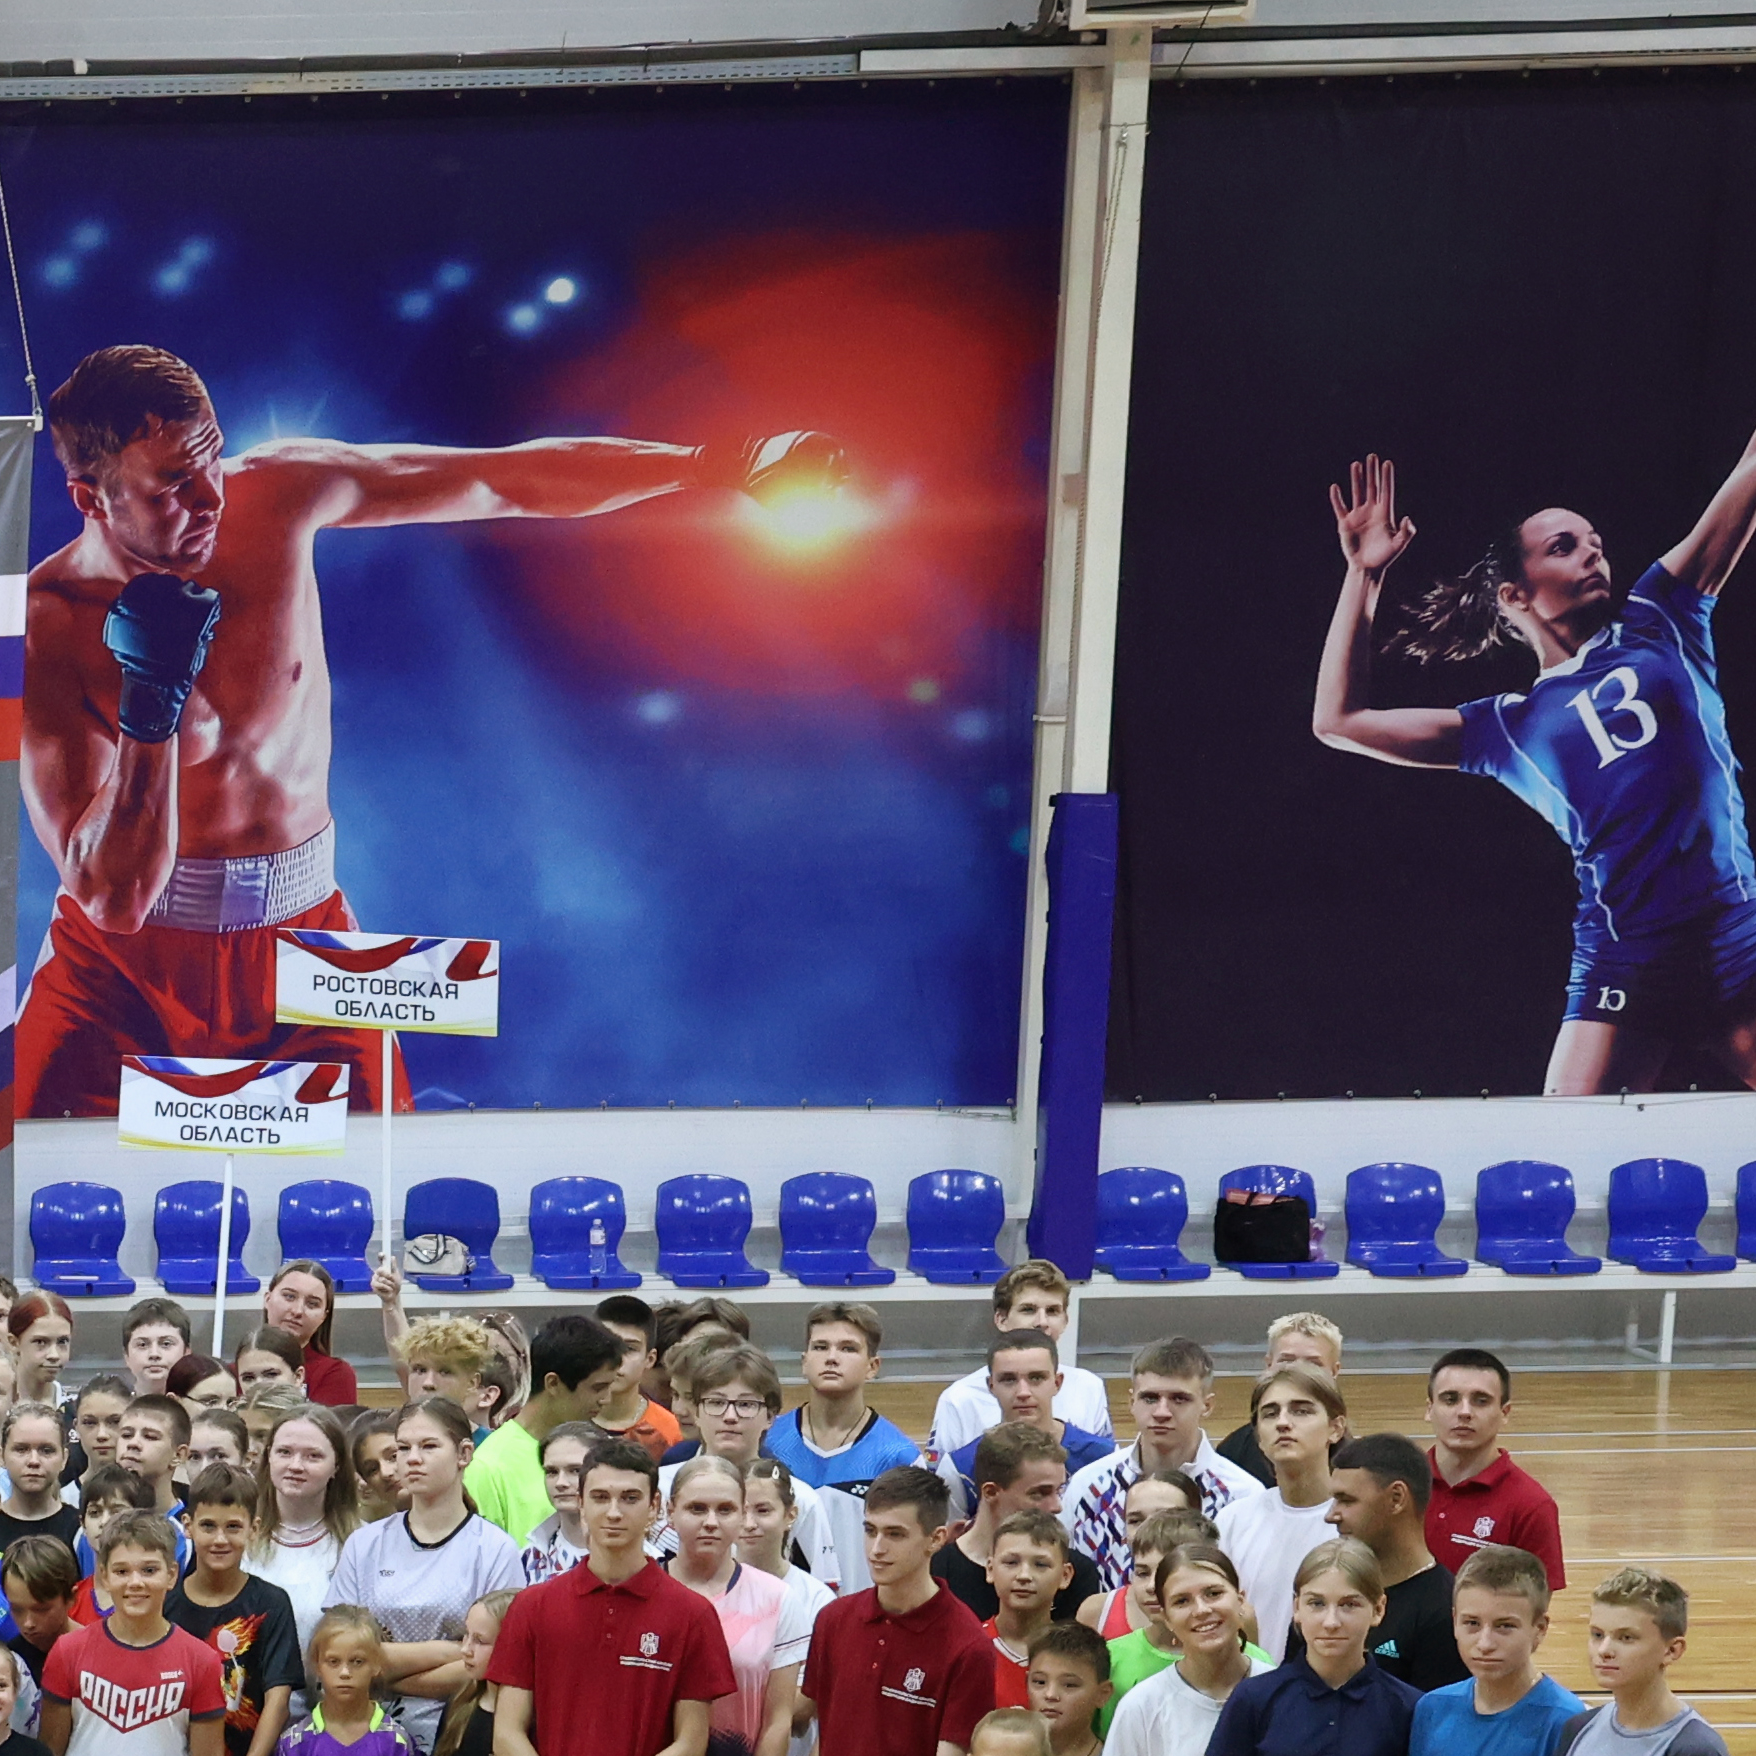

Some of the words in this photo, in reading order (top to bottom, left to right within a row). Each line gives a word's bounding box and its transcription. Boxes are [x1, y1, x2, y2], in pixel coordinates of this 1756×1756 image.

[1566, 666, 1658, 770] 13
[312, 975, 459, 1000] РОСТОВСКАЯ
[335, 1000, 436, 1022] ОБЛАСТЬ
[154, 1101, 309, 1124] МОСКОВСКАЯ
[179, 1124, 281, 1145] ОБЛАСТЬ
[79, 1670, 186, 1730] РОССИЯ
